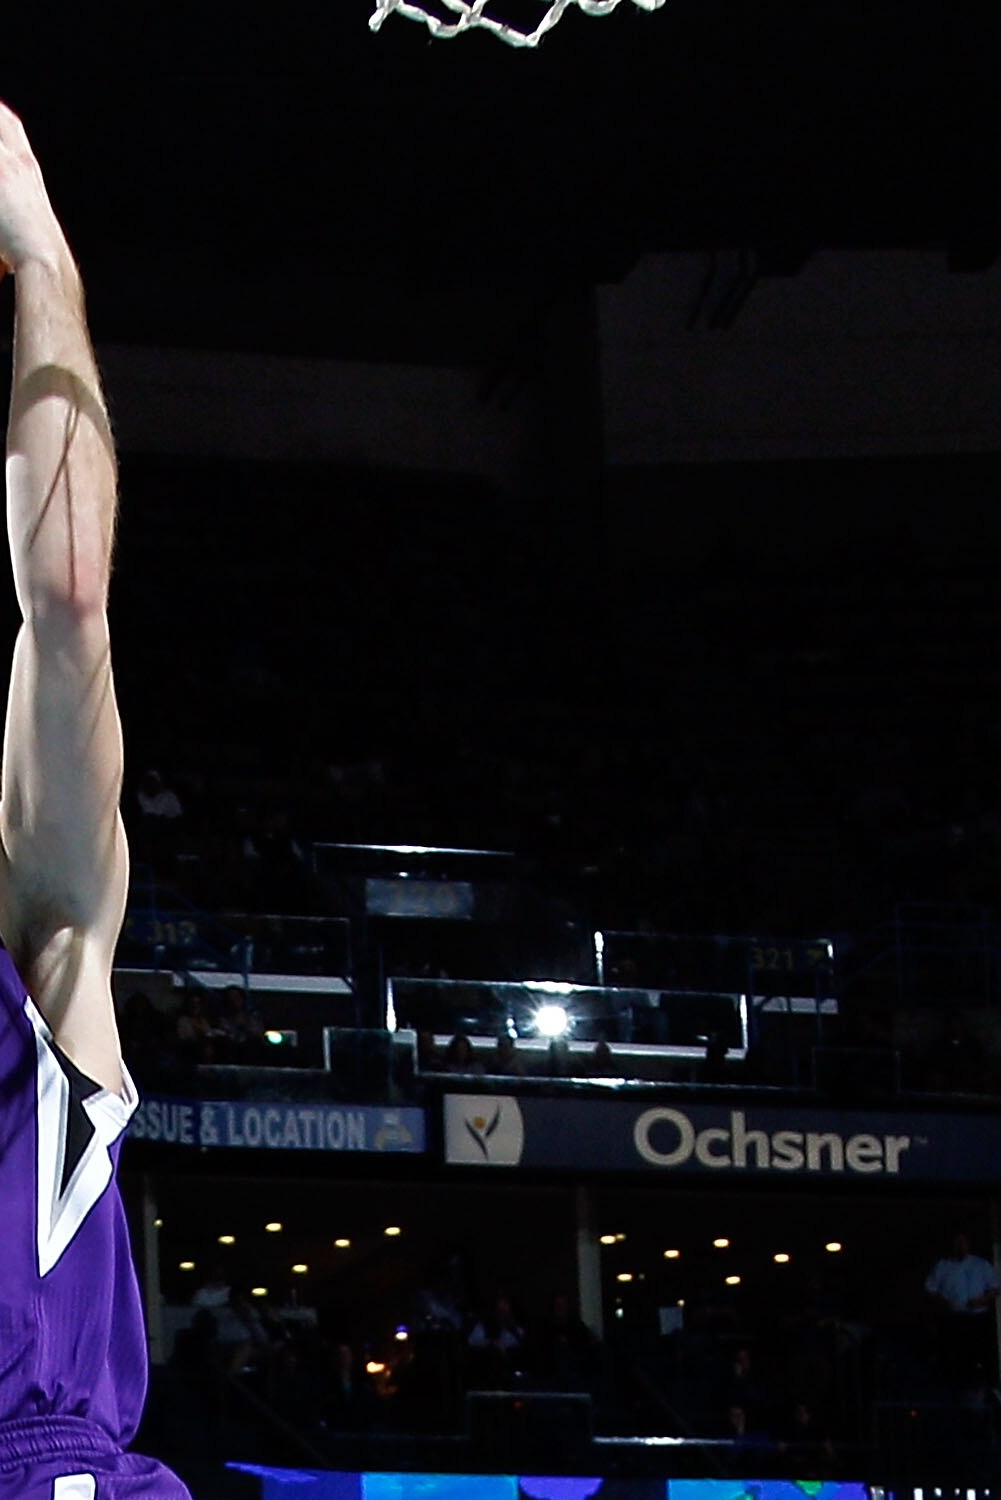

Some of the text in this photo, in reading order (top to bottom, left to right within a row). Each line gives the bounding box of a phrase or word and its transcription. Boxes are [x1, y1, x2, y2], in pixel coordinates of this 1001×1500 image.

[131, 1100, 367, 1150] SSUE & LOCATION
[633, 1106, 911, 1175] Ochsner
